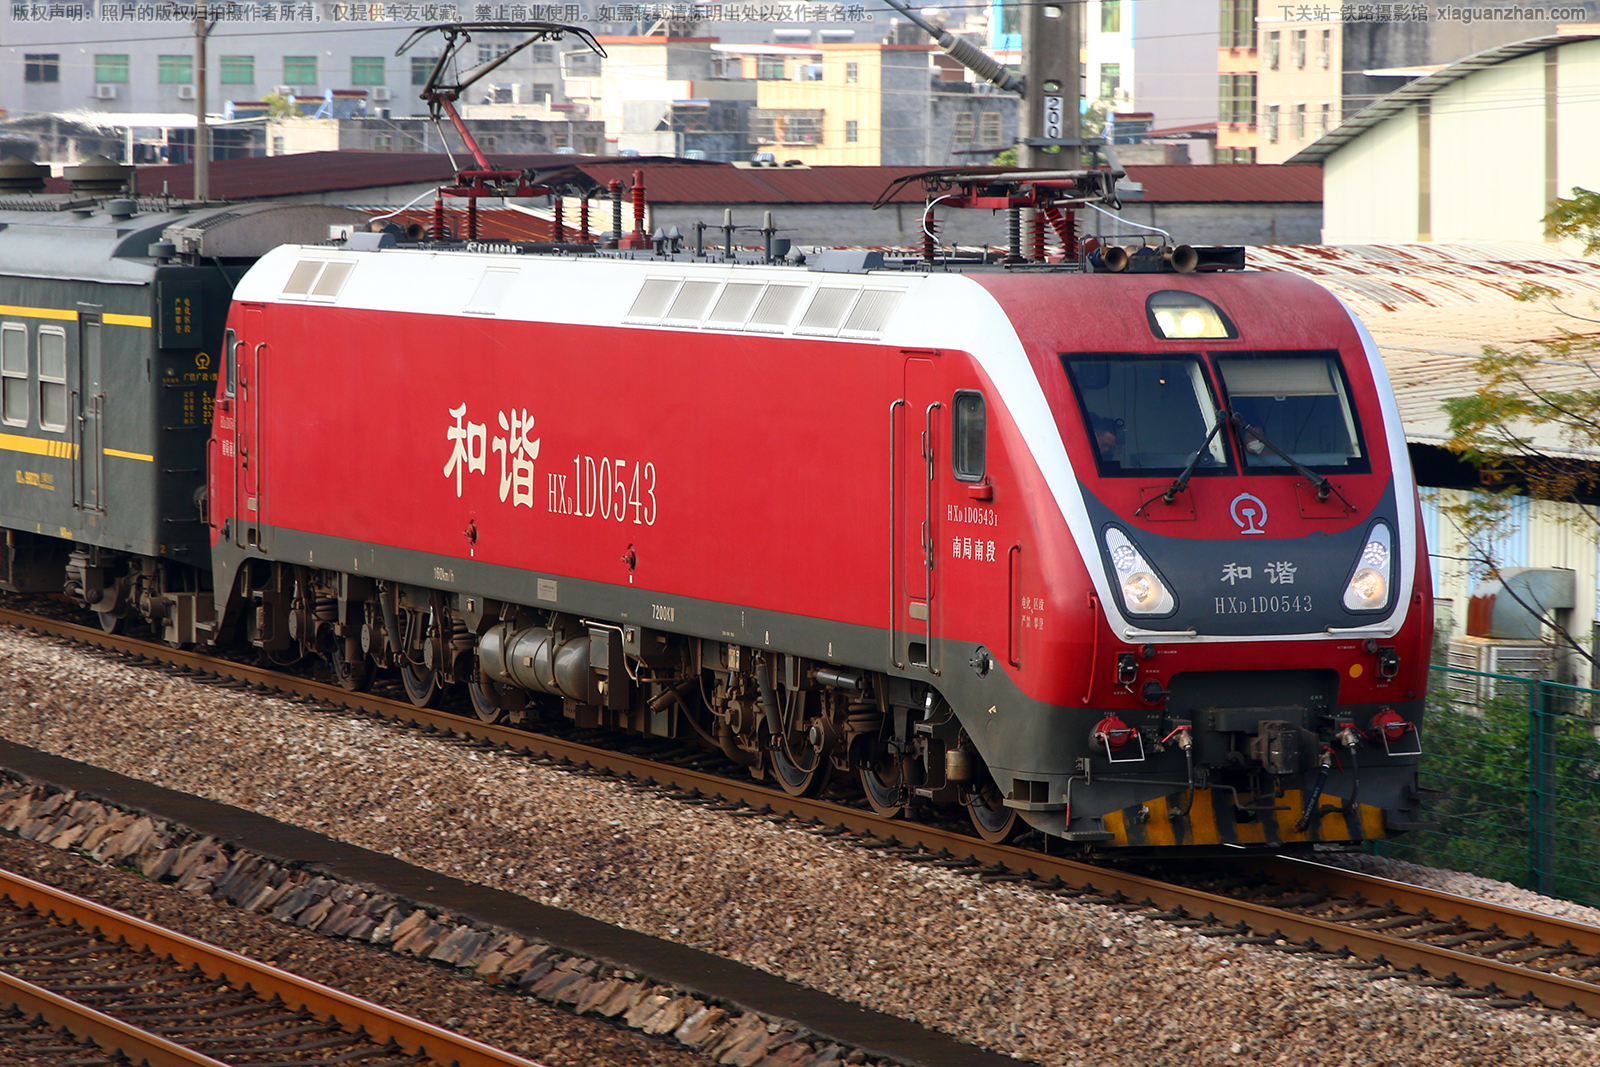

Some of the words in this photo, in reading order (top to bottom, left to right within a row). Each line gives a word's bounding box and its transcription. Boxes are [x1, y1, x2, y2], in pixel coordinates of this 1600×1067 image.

[1047, 97, 1060, 139] 200
[443, 401, 541, 508] 和谐
[547, 454, 657, 526] HXD1D0543
[159, 544, 167, 554] 2
[952, 536, 996, 562] 南局南段
[1220, 561, 1298, 586] 和谐
[652, 603, 675, 623] 7200KW
[1215, 595, 1314, 615] HXD1D0543
